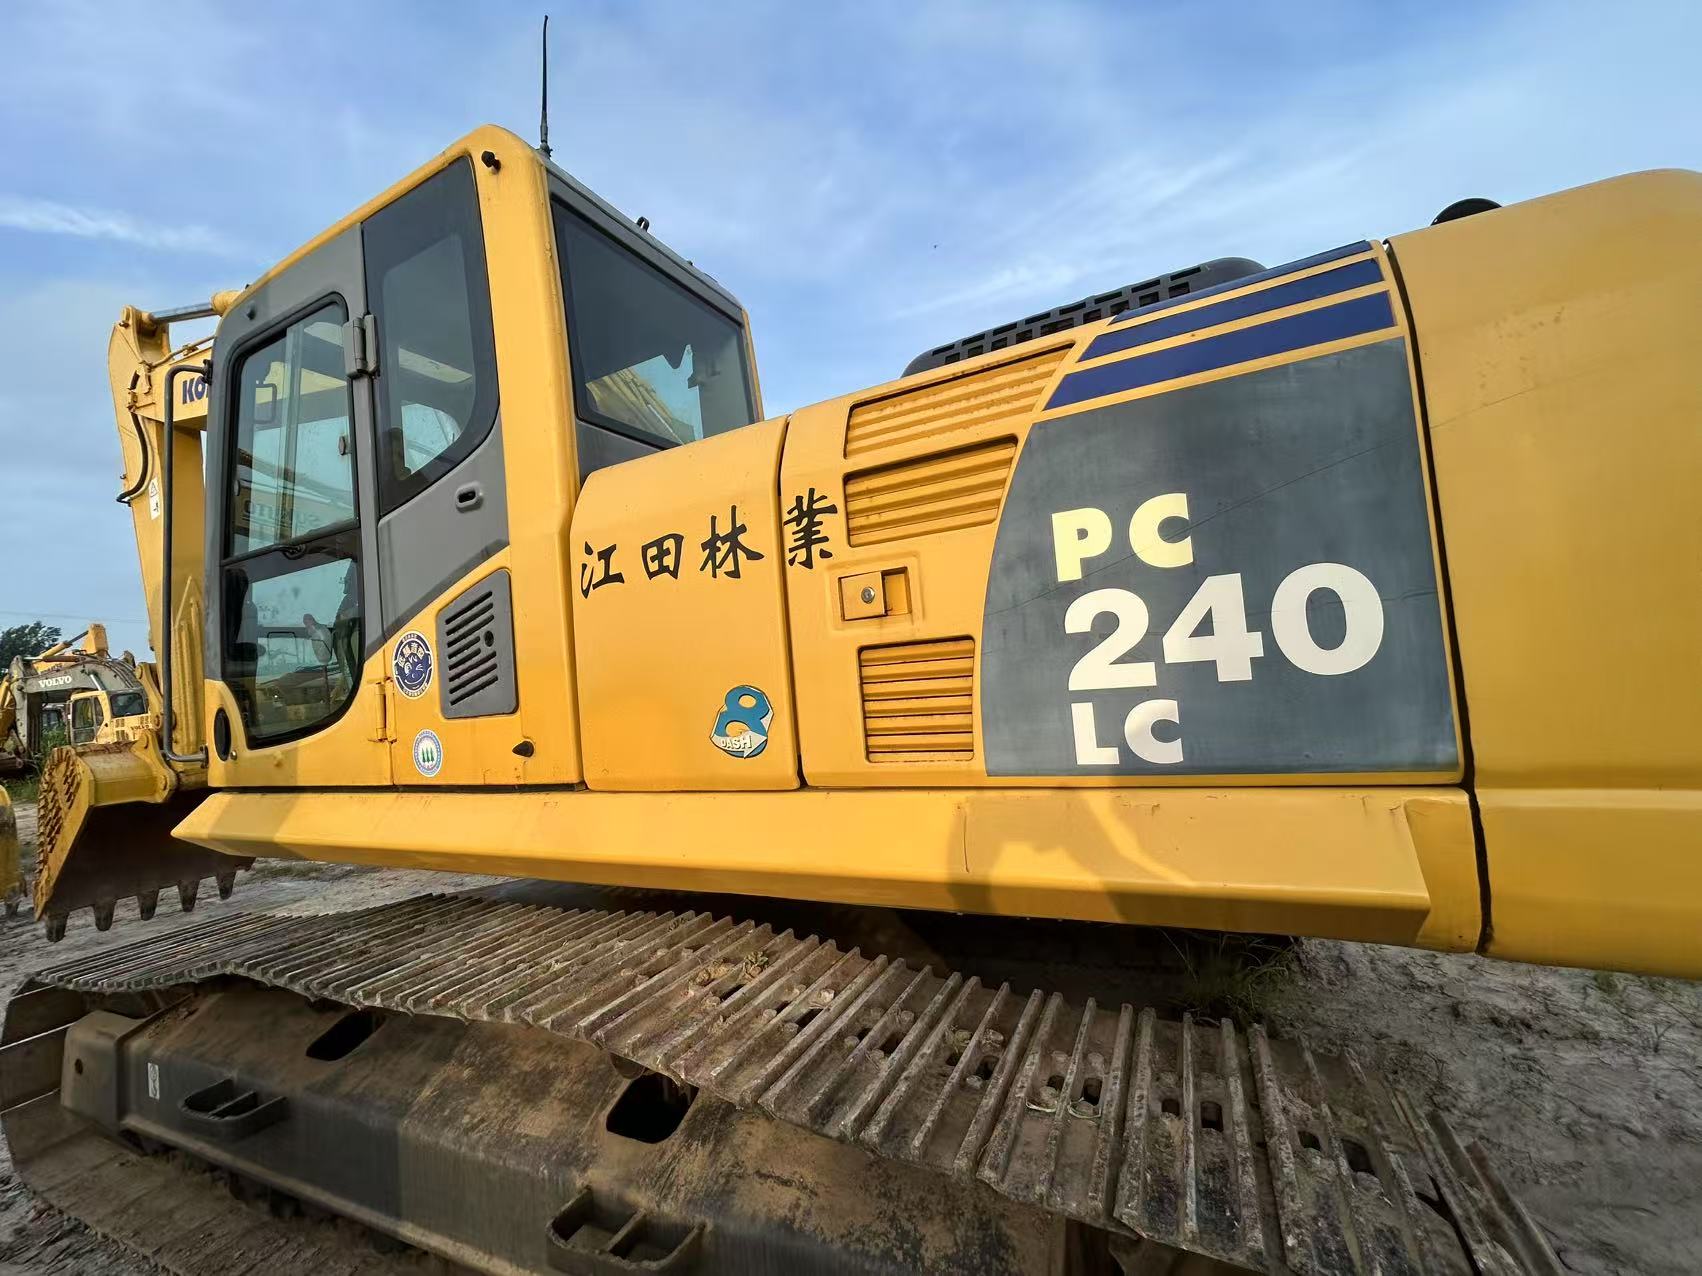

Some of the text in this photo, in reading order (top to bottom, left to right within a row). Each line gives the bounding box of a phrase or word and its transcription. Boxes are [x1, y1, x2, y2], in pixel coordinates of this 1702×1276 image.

[182, 376, 208, 405] KO
[580, 487, 838, 599] 江田林業
[1051, 492, 1194, 582] PC
[1064, 562, 1384, 691] 240
[38, 675, 72, 688] VOLVO
[720, 734, 753, 750] DASH
[1071, 698, 1184, 765] LC
